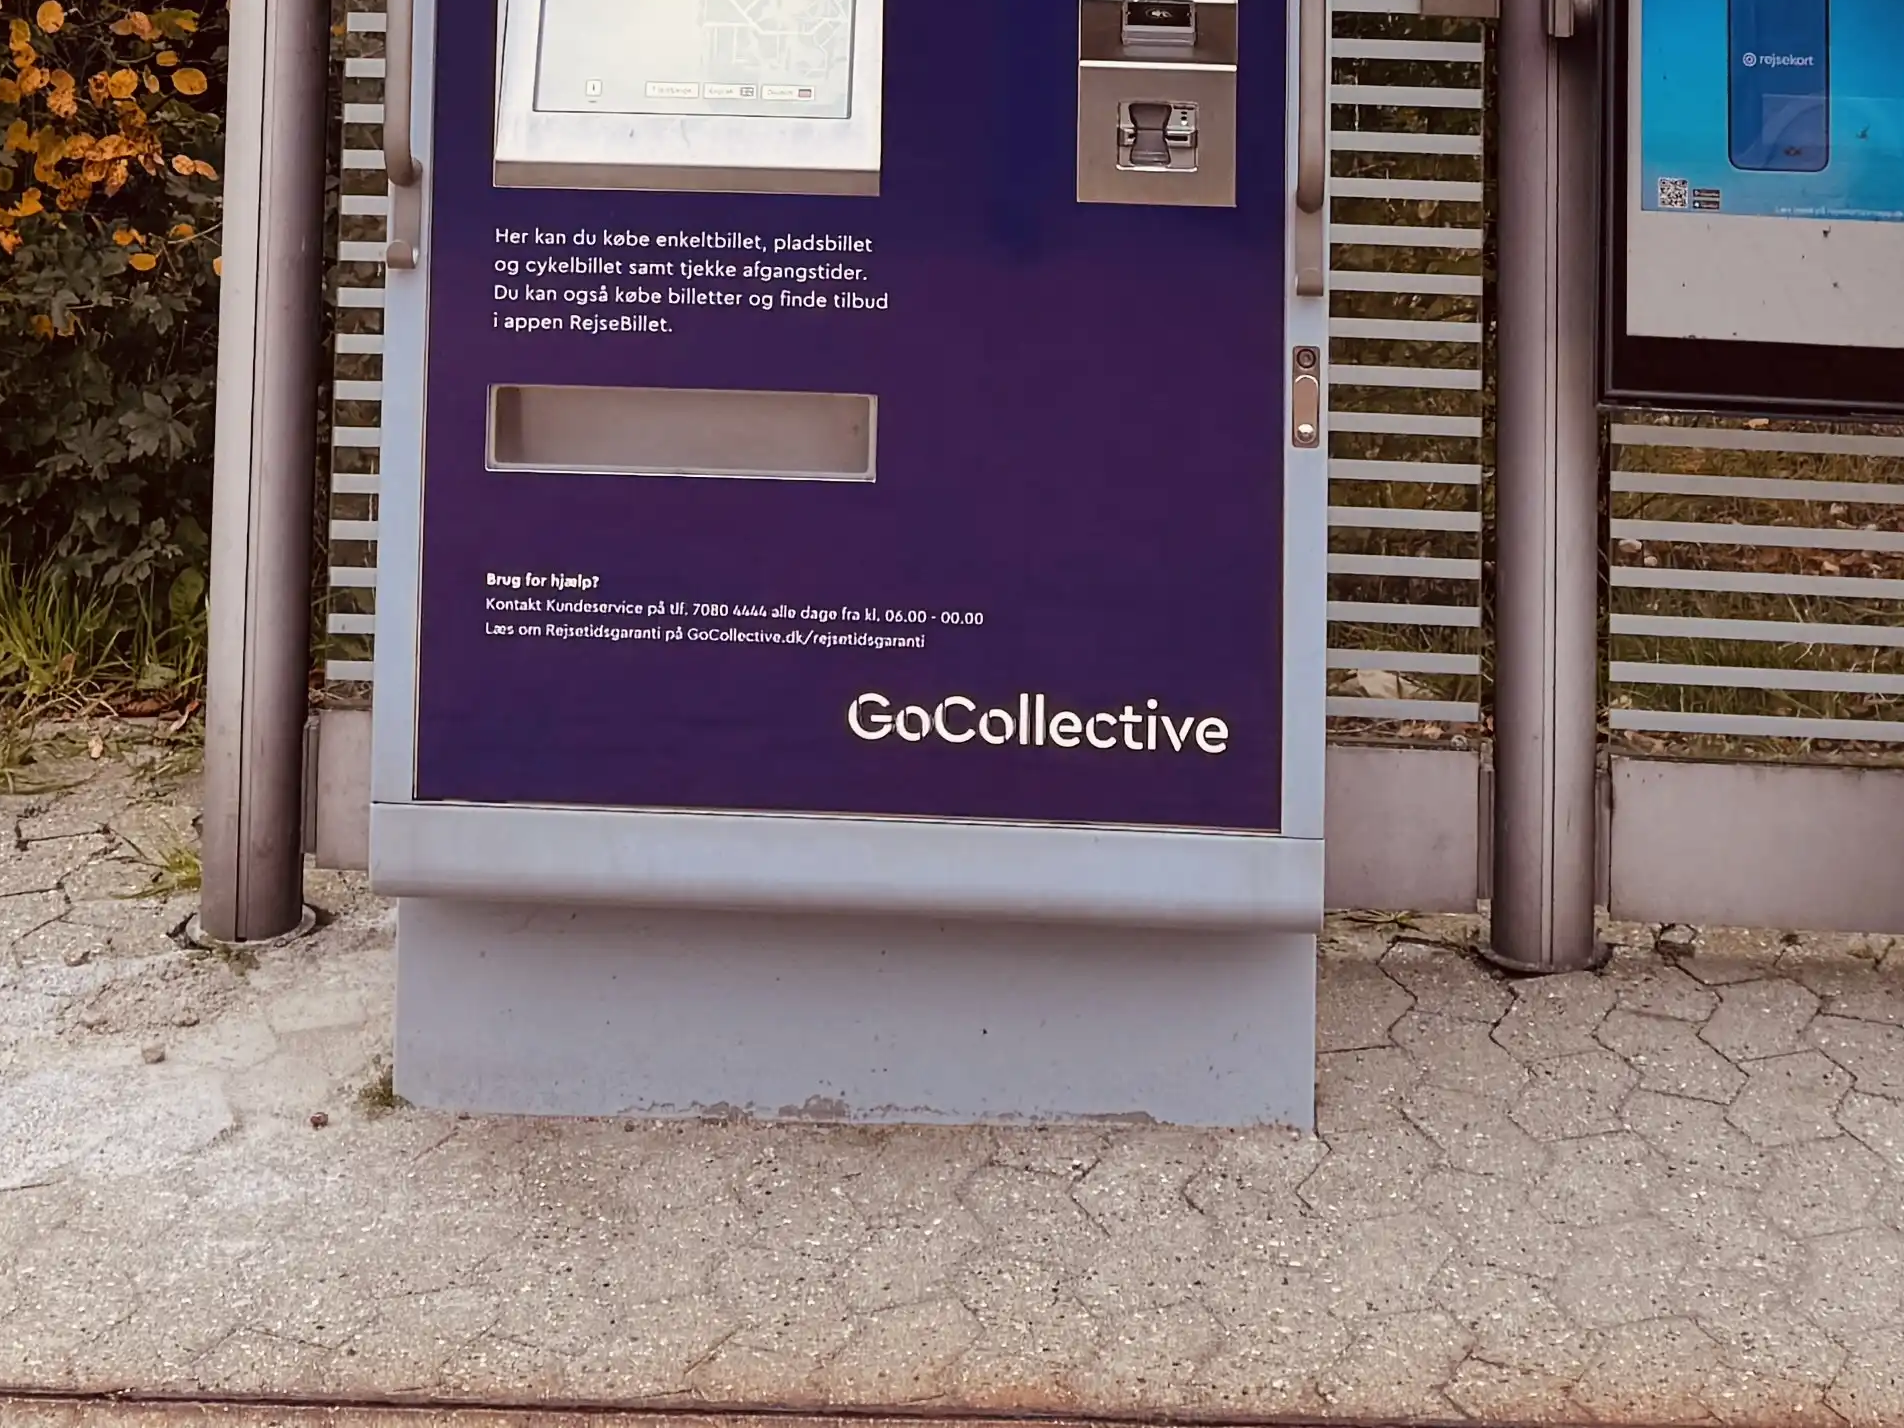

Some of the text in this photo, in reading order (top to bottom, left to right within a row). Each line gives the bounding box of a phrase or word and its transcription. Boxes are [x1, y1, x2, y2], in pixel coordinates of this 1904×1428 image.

[1759, 52, 1813, 68] rejsekort
[495, 228, 873, 255] Her kan du købe enkeltbillet, pladsbillet
[494, 258, 868, 283] og cykelbillet samt tjekke afgangstider.
[494, 284, 888, 310] Du kan også købe billetter og finde tilbud
[493, 312, 673, 335] i appen RejseBillet.
[487, 573, 600, 590] Brug for hjælp?
[486, 598, 542, 612] Kontakt
[546, 599, 643, 614] Kundeservice
[647, 601, 665, 617] på
[670, 602, 688, 616] tlf.
[692, 603, 728, 616] 7080
[733, 605, 767, 618] 4444
[771, 605, 796, 619] alle
[800, 605, 837, 623] dage
[841, 606, 861, 621] fra
[865, 608, 880, 622] kl.
[885, 610, 927, 623] 06.00
[941, 612, 984, 625] 00.00
[486, 622, 514, 635] Læs
[519, 625, 541, 636] om
[546, 624, 661, 640] Rejsetidsgaranti
[665, 626, 683, 642] på
[848, 692, 1229, 754] GoCollective
